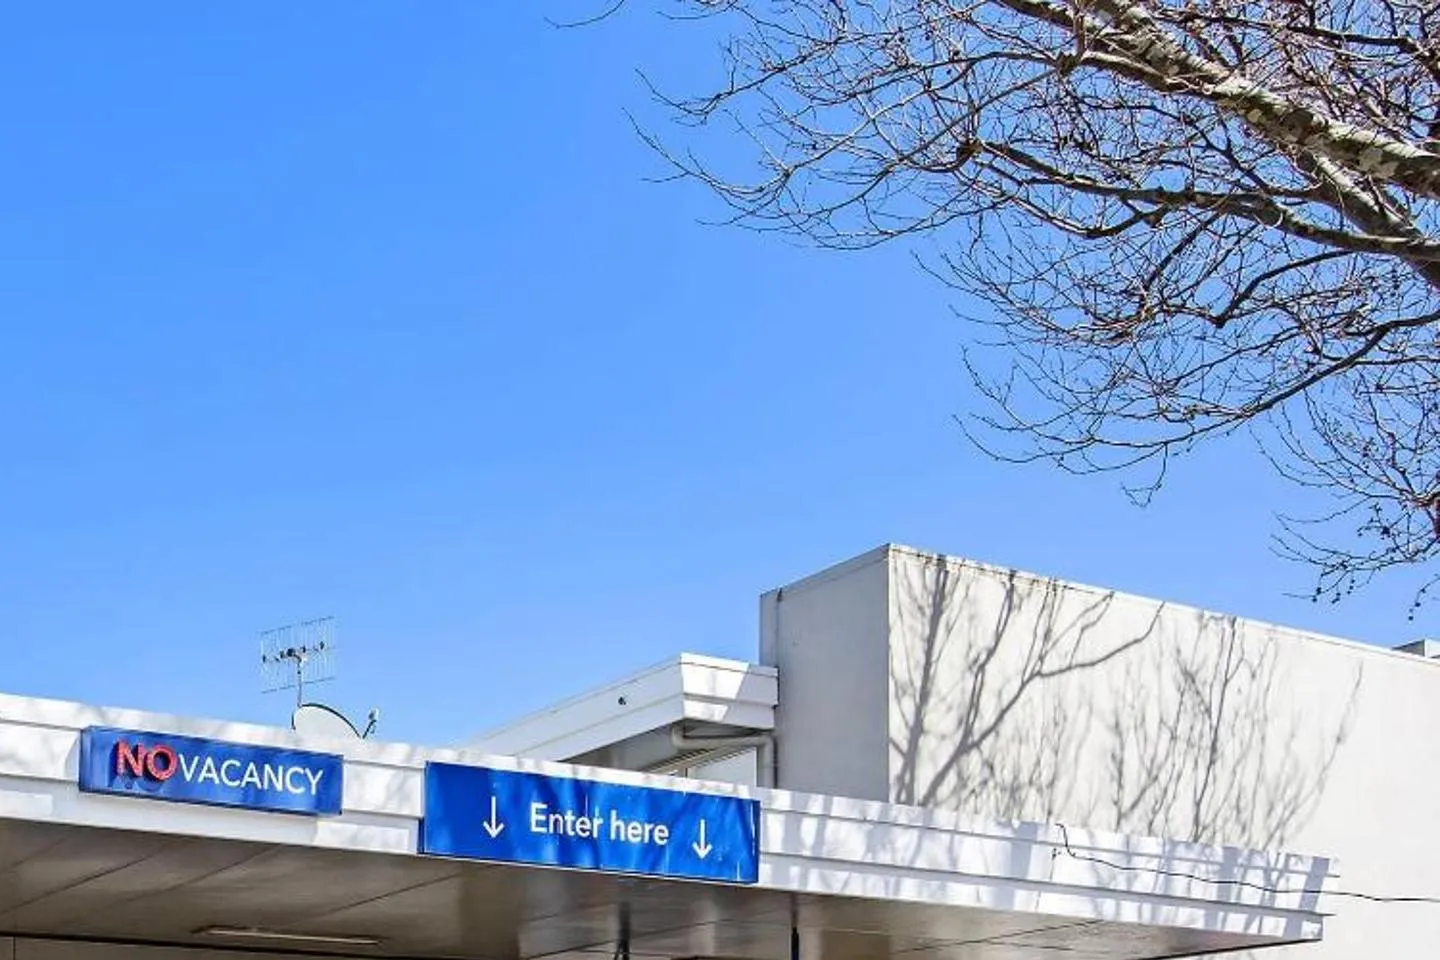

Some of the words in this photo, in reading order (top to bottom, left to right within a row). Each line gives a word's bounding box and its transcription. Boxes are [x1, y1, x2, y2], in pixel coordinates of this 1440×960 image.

[114, 738, 178, 781] NO
[179, 753, 323, 796] VACANCY
[529, 801, 604, 839] Enter
[609, 809, 669, 846] here
